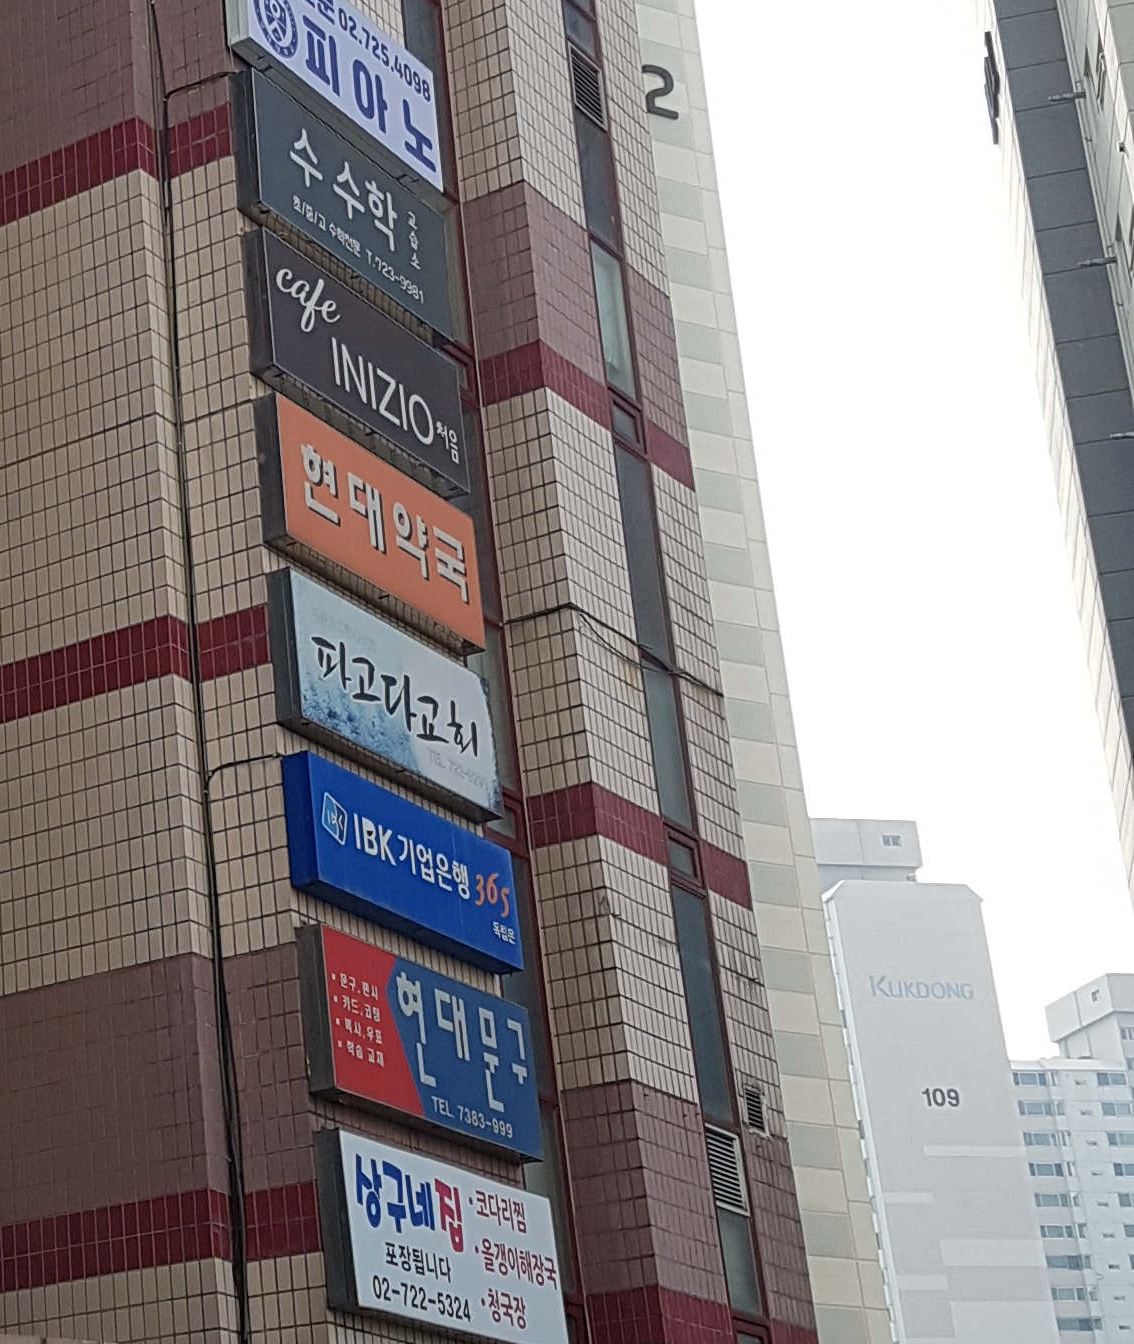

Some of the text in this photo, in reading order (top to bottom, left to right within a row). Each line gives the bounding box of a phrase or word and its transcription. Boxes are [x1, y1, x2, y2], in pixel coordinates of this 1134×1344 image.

[338, 9, 431, 103] 02.725.4098
[303, 14, 437, 173] 피아노
[641, 64, 679, 121] 2
[276, 268, 341, 333] cafe
[331, 336, 460, 464] INIZIO 처음
[300, 443, 469, 605] 현대약국
[311, 636, 478, 757] 파고다교회
[474, 873, 510, 918] 365
[869, 975, 973, 999] KUKDONG
[396, 971, 528, 1113] 현대문구
[458, 1105, 513, 1139] 7383-999
[922, 1087, 960, 1107] 109
[356, 1153, 464, 1253] 상구네집
[476, 1190, 527, 1234] 코다리찜
[385, 1241, 452, 1283] 포장됩니다
[481, 1238, 558, 1290] 올갱이해장국
[373, 1274, 471, 1323] 02-722-5324
[488, 1288, 527, 1330] 청국장
